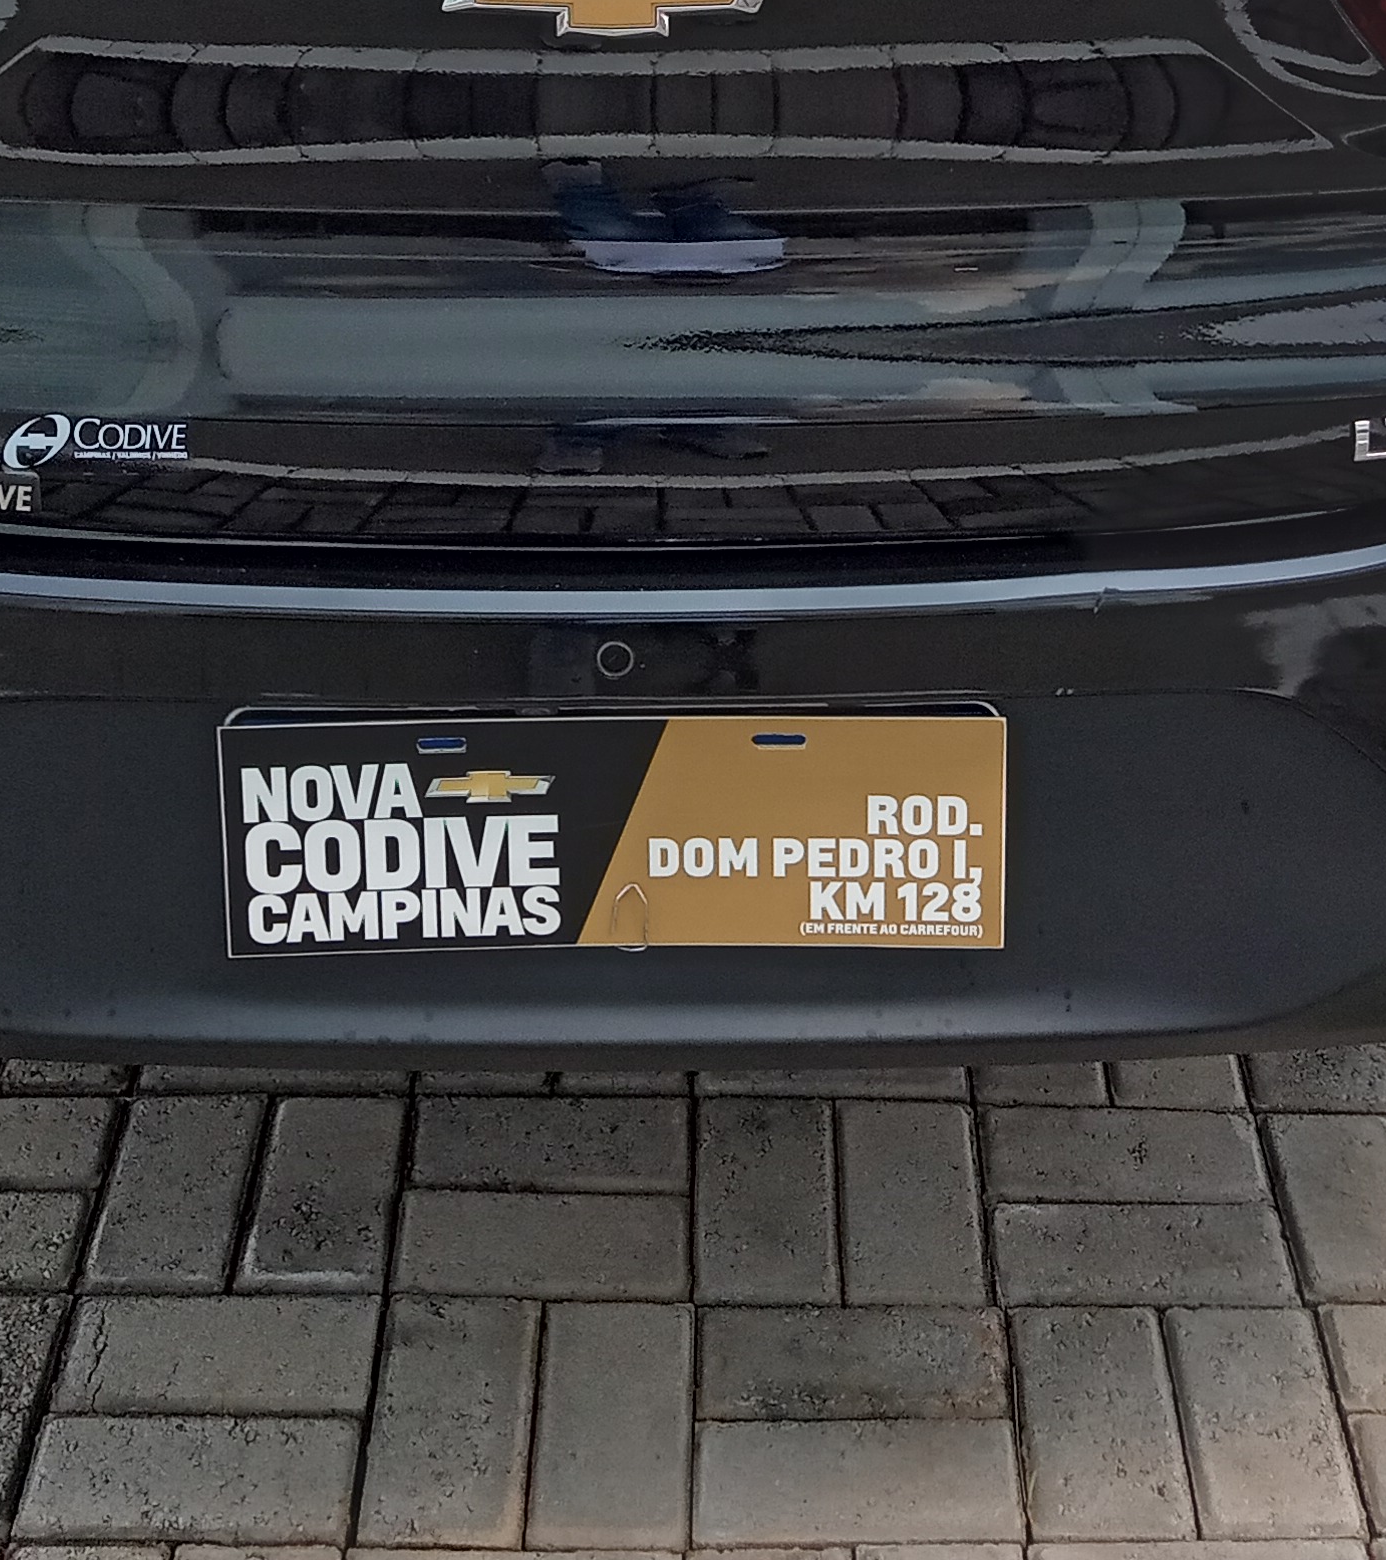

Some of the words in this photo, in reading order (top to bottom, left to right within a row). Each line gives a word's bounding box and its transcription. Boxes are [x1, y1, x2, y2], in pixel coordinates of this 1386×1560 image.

[73, 418, 187, 450] CODIVE
[241, 763, 423, 823] NOVA
[867, 795, 983, 835] ROD.
[245, 815, 560, 894] CODIVE
[649, 838, 758, 877] DOM
[773, 838, 939, 879] PEDRO
[954, 840, 983, 887] I,
[248, 886, 561, 944] CAMPINAS
[810, 881, 885, 921] KM
[897, 882, 983, 922] 128
[800, 923, 825, 937] (EM
[827, 924, 877, 935] FRENTE
[879, 924, 898, 935] AO
[899, 924, 983, 938] CARREFOUR)
